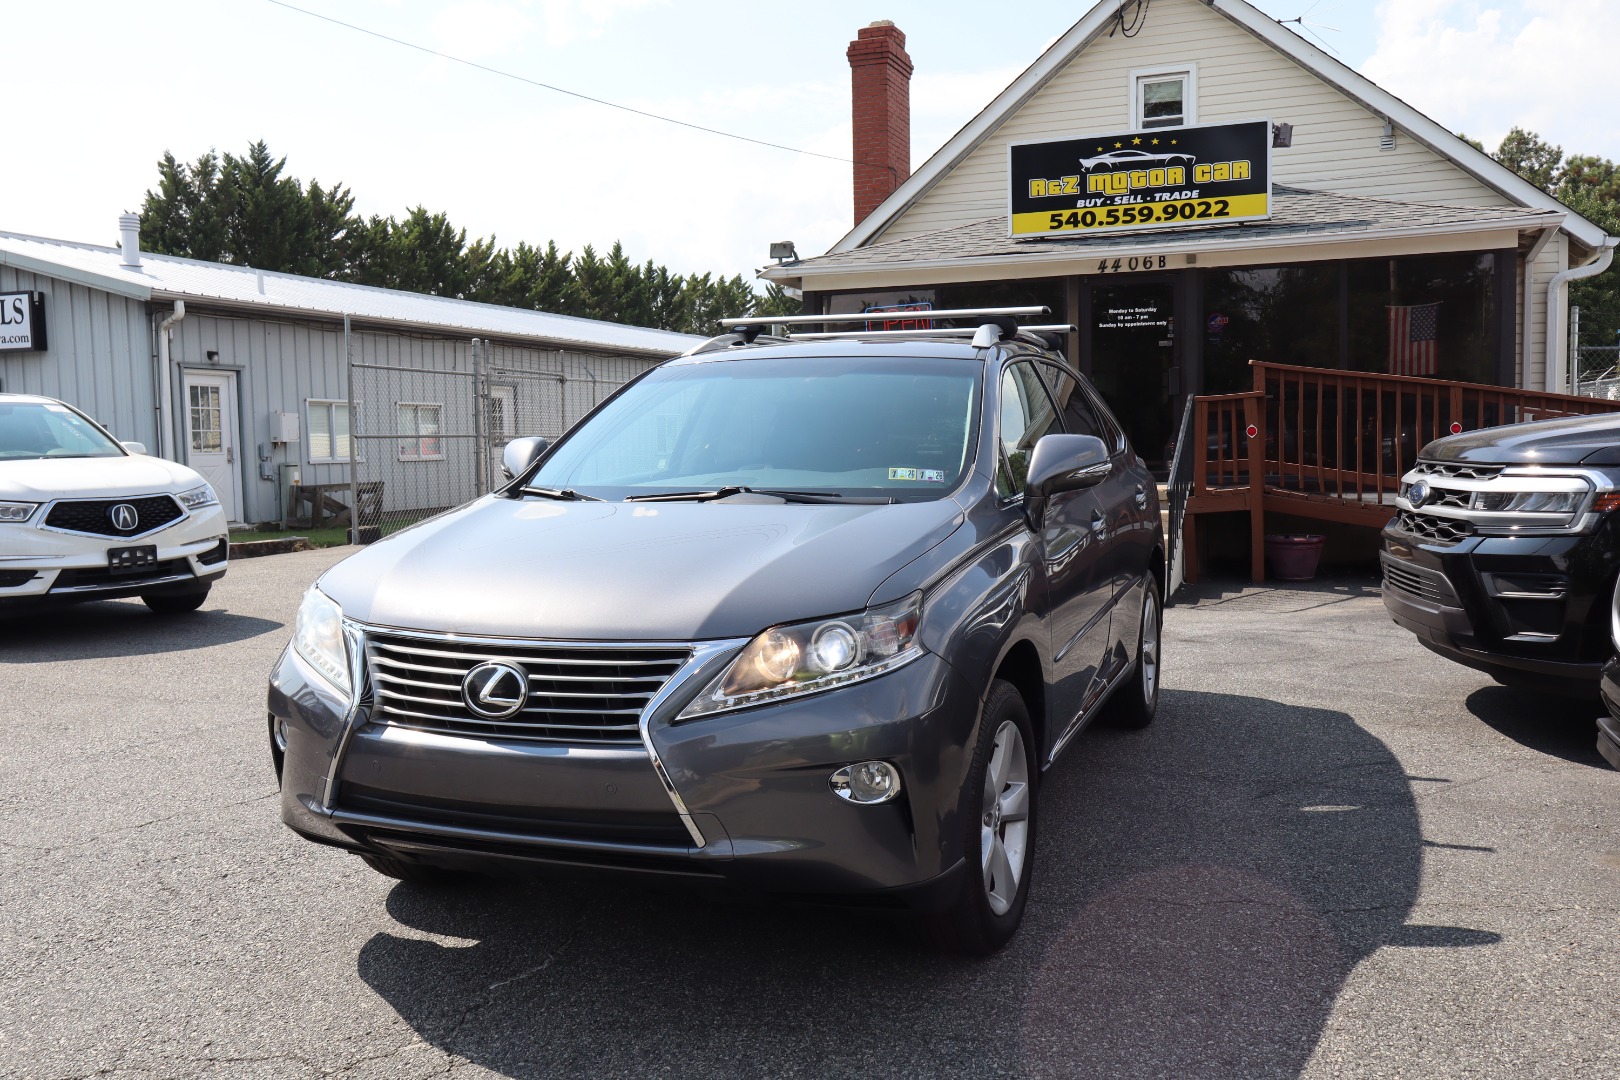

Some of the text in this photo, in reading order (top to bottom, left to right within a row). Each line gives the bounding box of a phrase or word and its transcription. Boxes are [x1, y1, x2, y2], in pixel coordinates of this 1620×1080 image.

[1029, 175, 1080, 198] R&Z
[1076, 189, 1200, 208] BUY SELL TRADE
[1049, 199, 1230, 230] 540.559.9022
